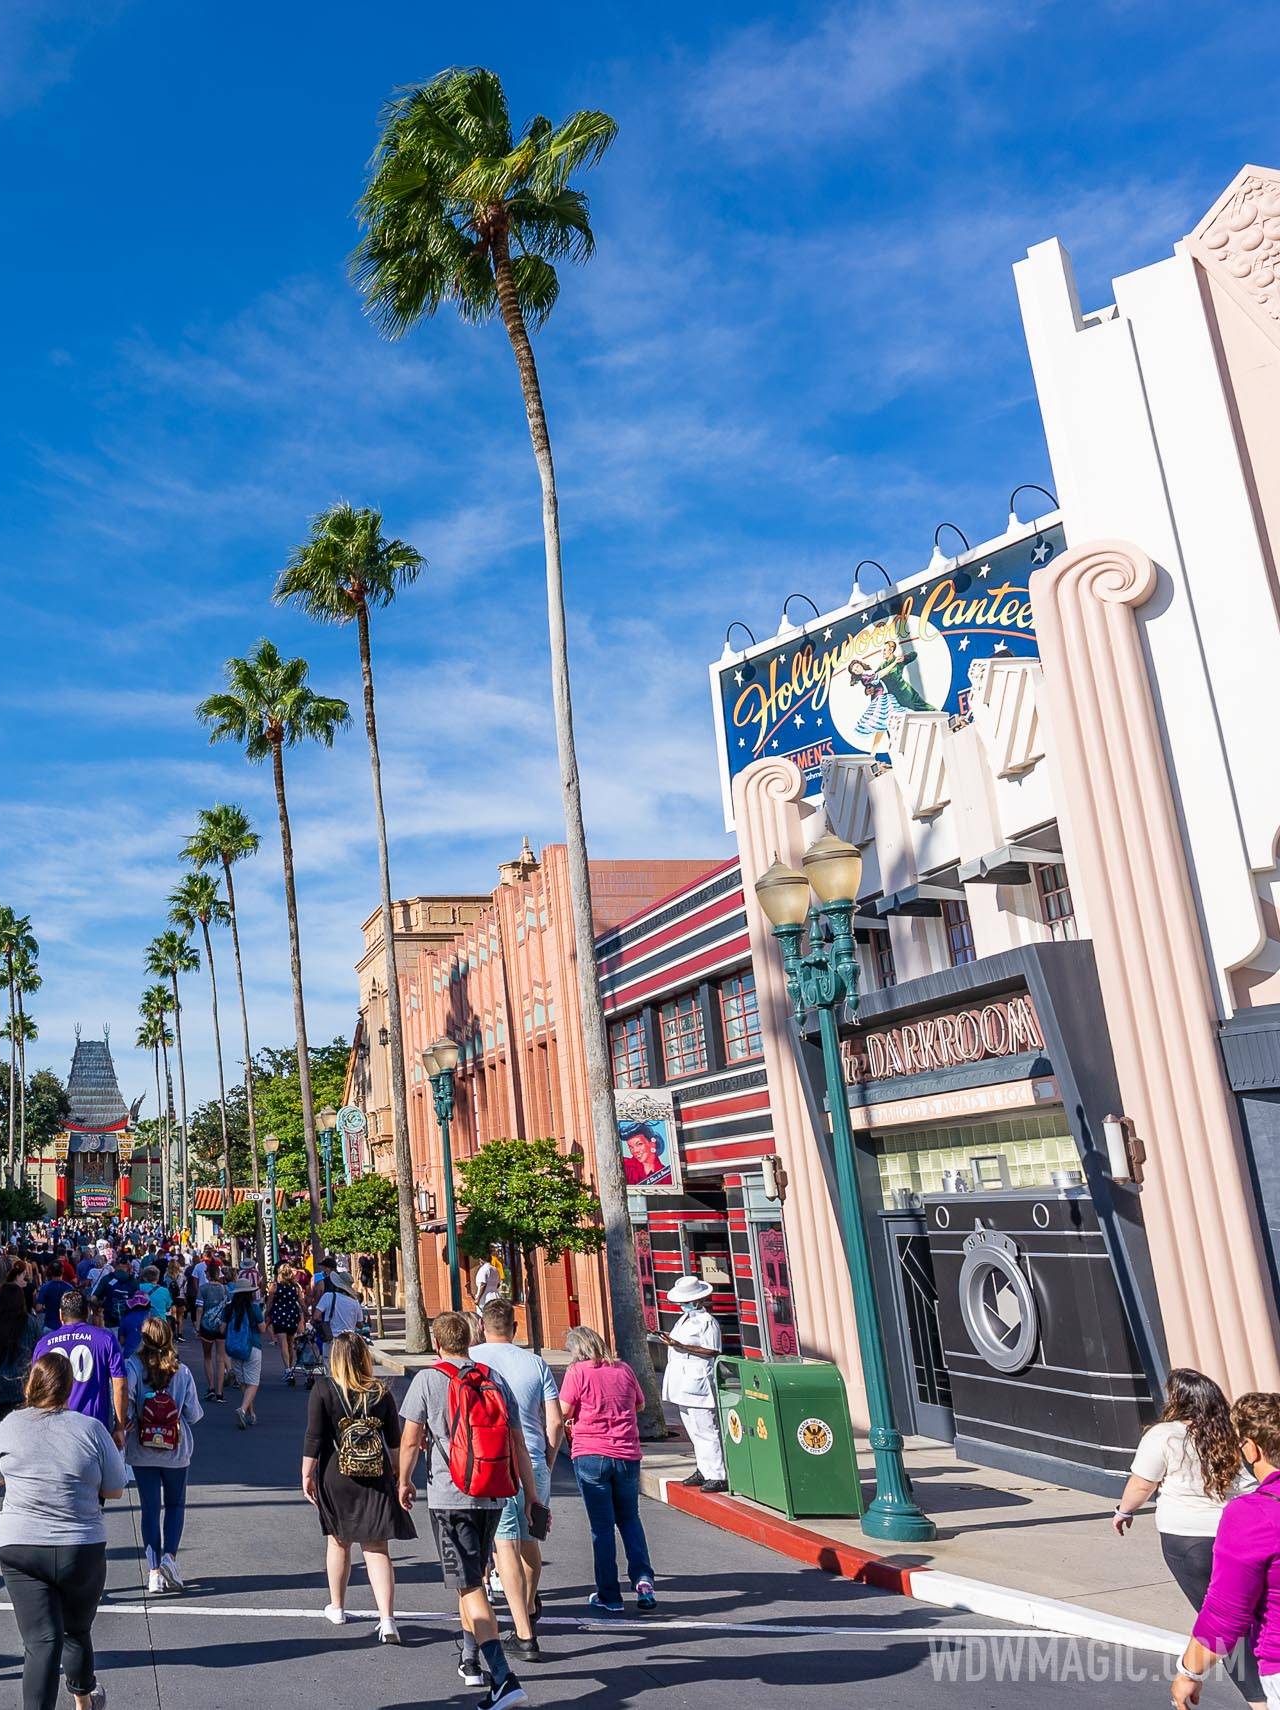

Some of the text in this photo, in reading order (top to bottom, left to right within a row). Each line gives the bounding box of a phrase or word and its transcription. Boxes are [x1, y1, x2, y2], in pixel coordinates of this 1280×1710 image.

[733, 579, 1037, 751] Hollywood Cantee
[866, 998, 1038, 1078] DARKROOM
[47, 1332, 92, 1346] STREET TEAM
[442, 1540, 460, 1577] JUST
